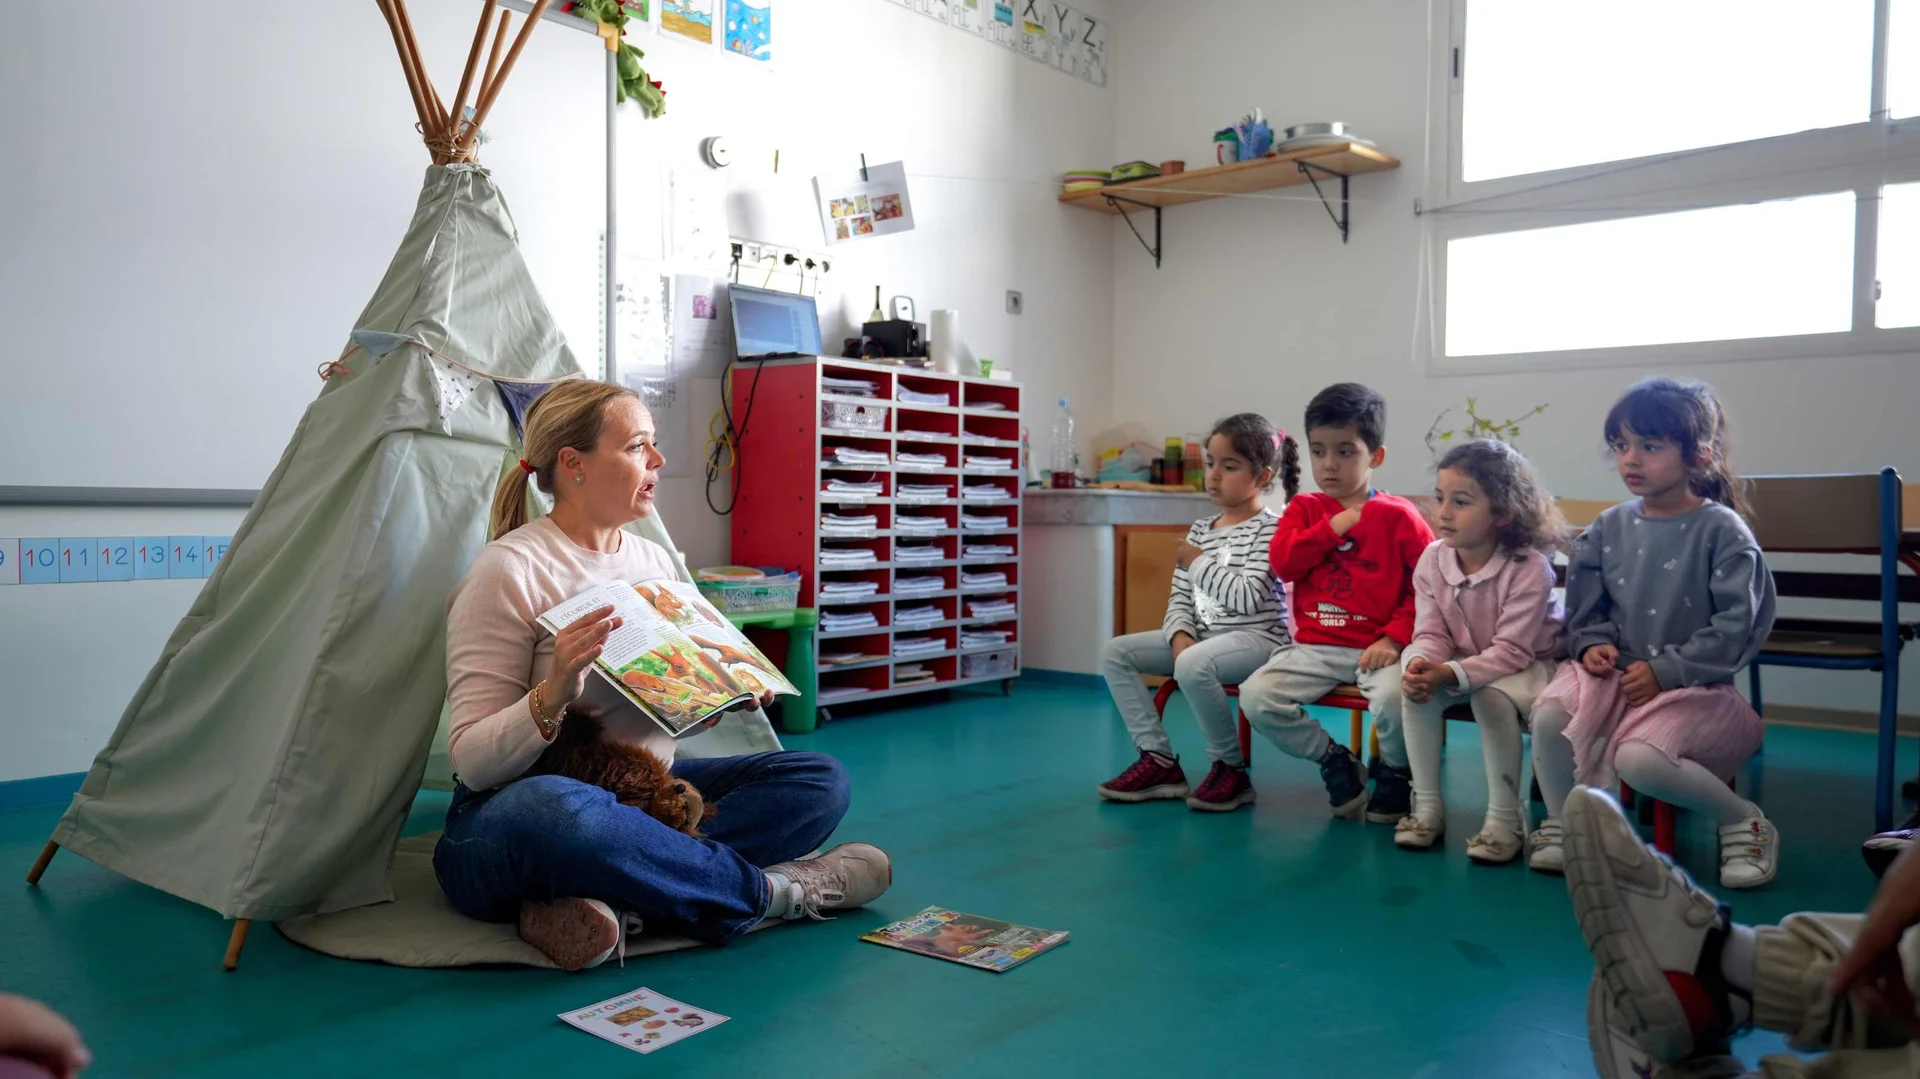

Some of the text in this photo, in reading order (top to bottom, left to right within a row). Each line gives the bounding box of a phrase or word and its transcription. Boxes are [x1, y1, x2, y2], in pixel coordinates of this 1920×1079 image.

[1023, 0, 1039, 21] X
[1053, 3, 1069, 33] Y
[1082, 17, 1096, 48] Z
[25, 548, 55, 567] 10
[62, 547, 88, 567] 11
[101, 546, 129, 565] 12
[139, 545, 165, 564] 13
[174, 545, 199, 563] 14
[577, 993, 648, 1021] AUTOMNE
